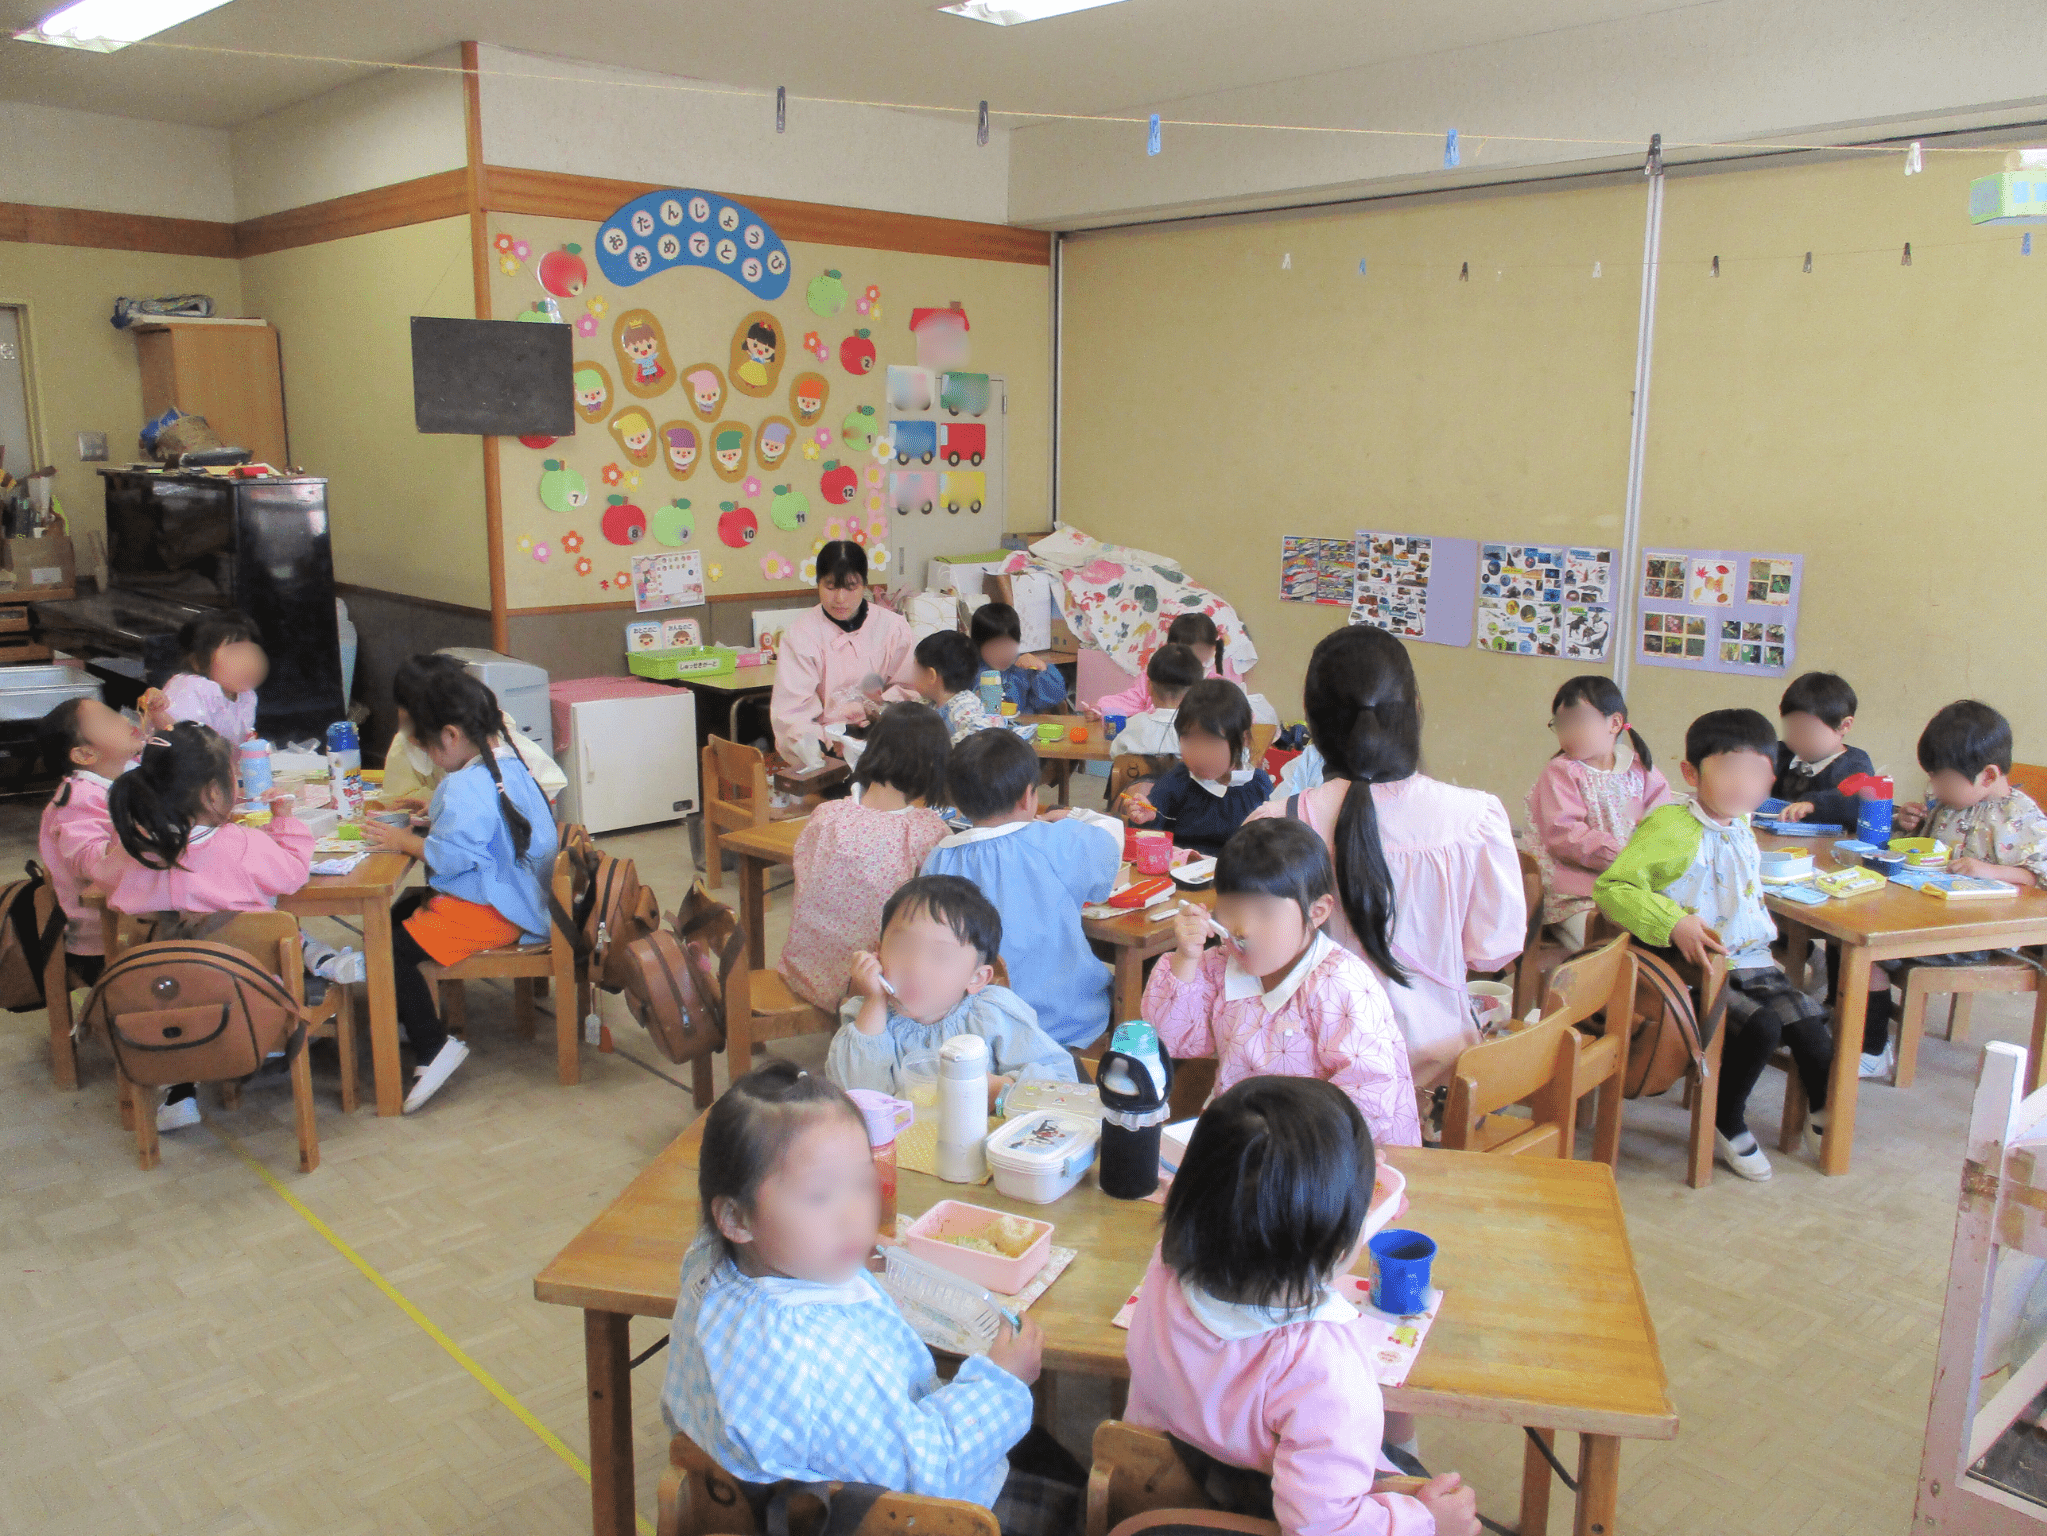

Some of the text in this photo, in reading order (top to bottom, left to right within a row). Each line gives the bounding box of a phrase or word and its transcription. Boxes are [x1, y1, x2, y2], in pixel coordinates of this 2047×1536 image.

[634, 239, 758, 277] おめでとう
[843, 488, 854, 498] 12
[572, 494, 579, 504] 7
[796, 513, 805, 523] 11
[631, 529, 638, 539] 8
[744, 530, 754, 540] 10
